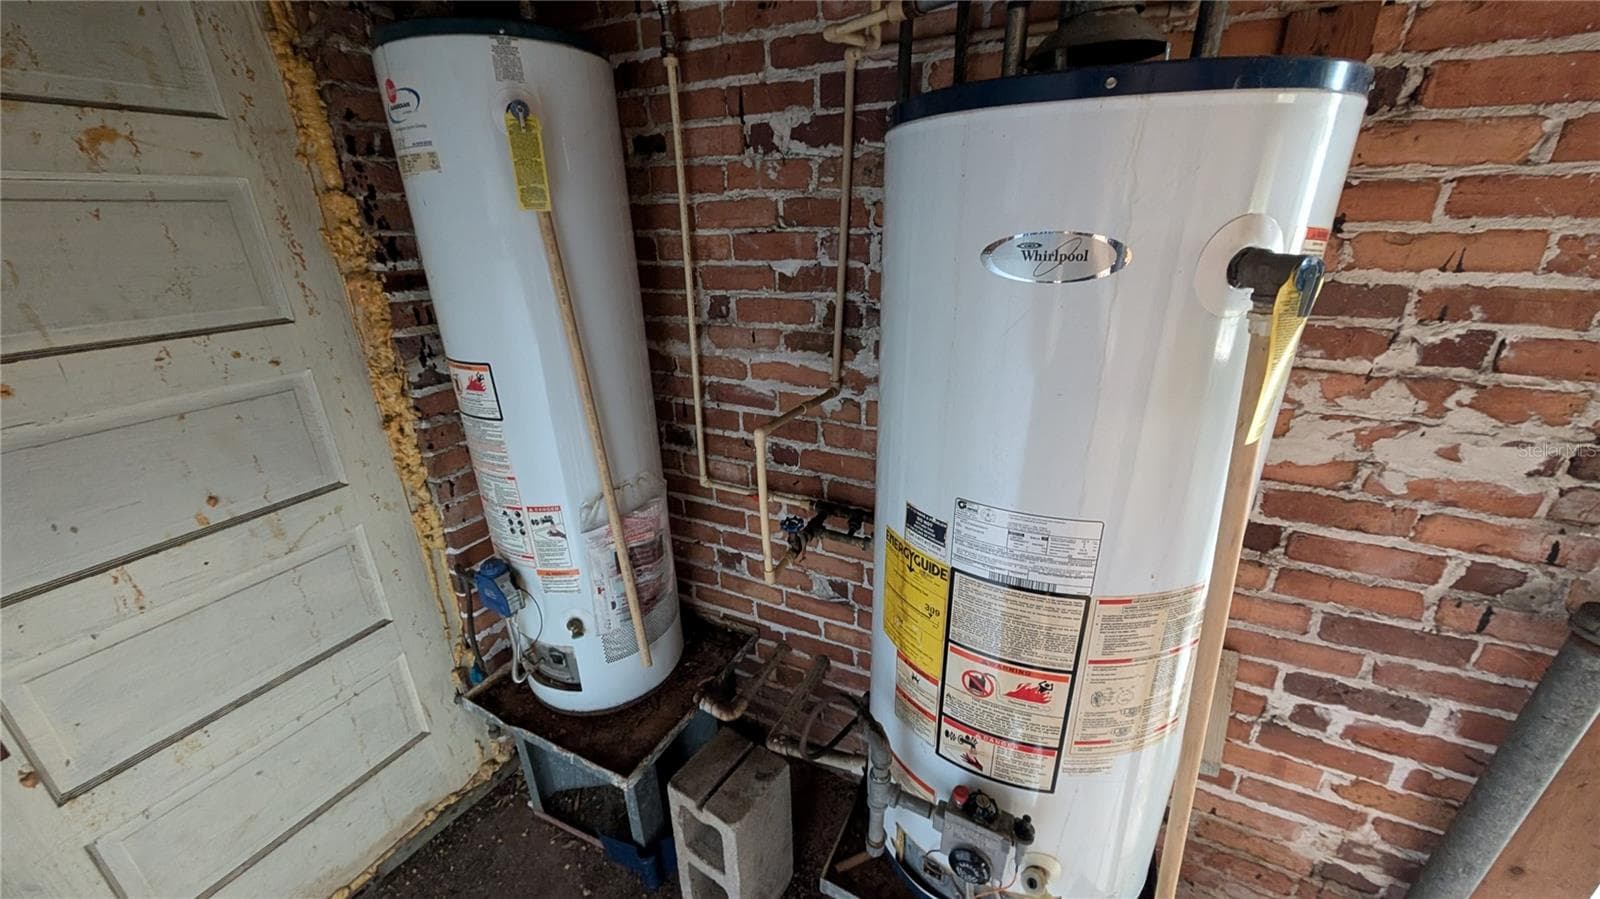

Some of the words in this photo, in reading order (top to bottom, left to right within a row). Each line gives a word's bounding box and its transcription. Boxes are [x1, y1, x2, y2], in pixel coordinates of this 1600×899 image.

[1021, 249, 1088, 264] Whirlpool
[886, 529, 948, 581] ENERGYGUIDE
[924, 603, 941, 617] 309
[991, 661, 1031, 677] WARNING
[983, 735, 1018, 750] DANGER
